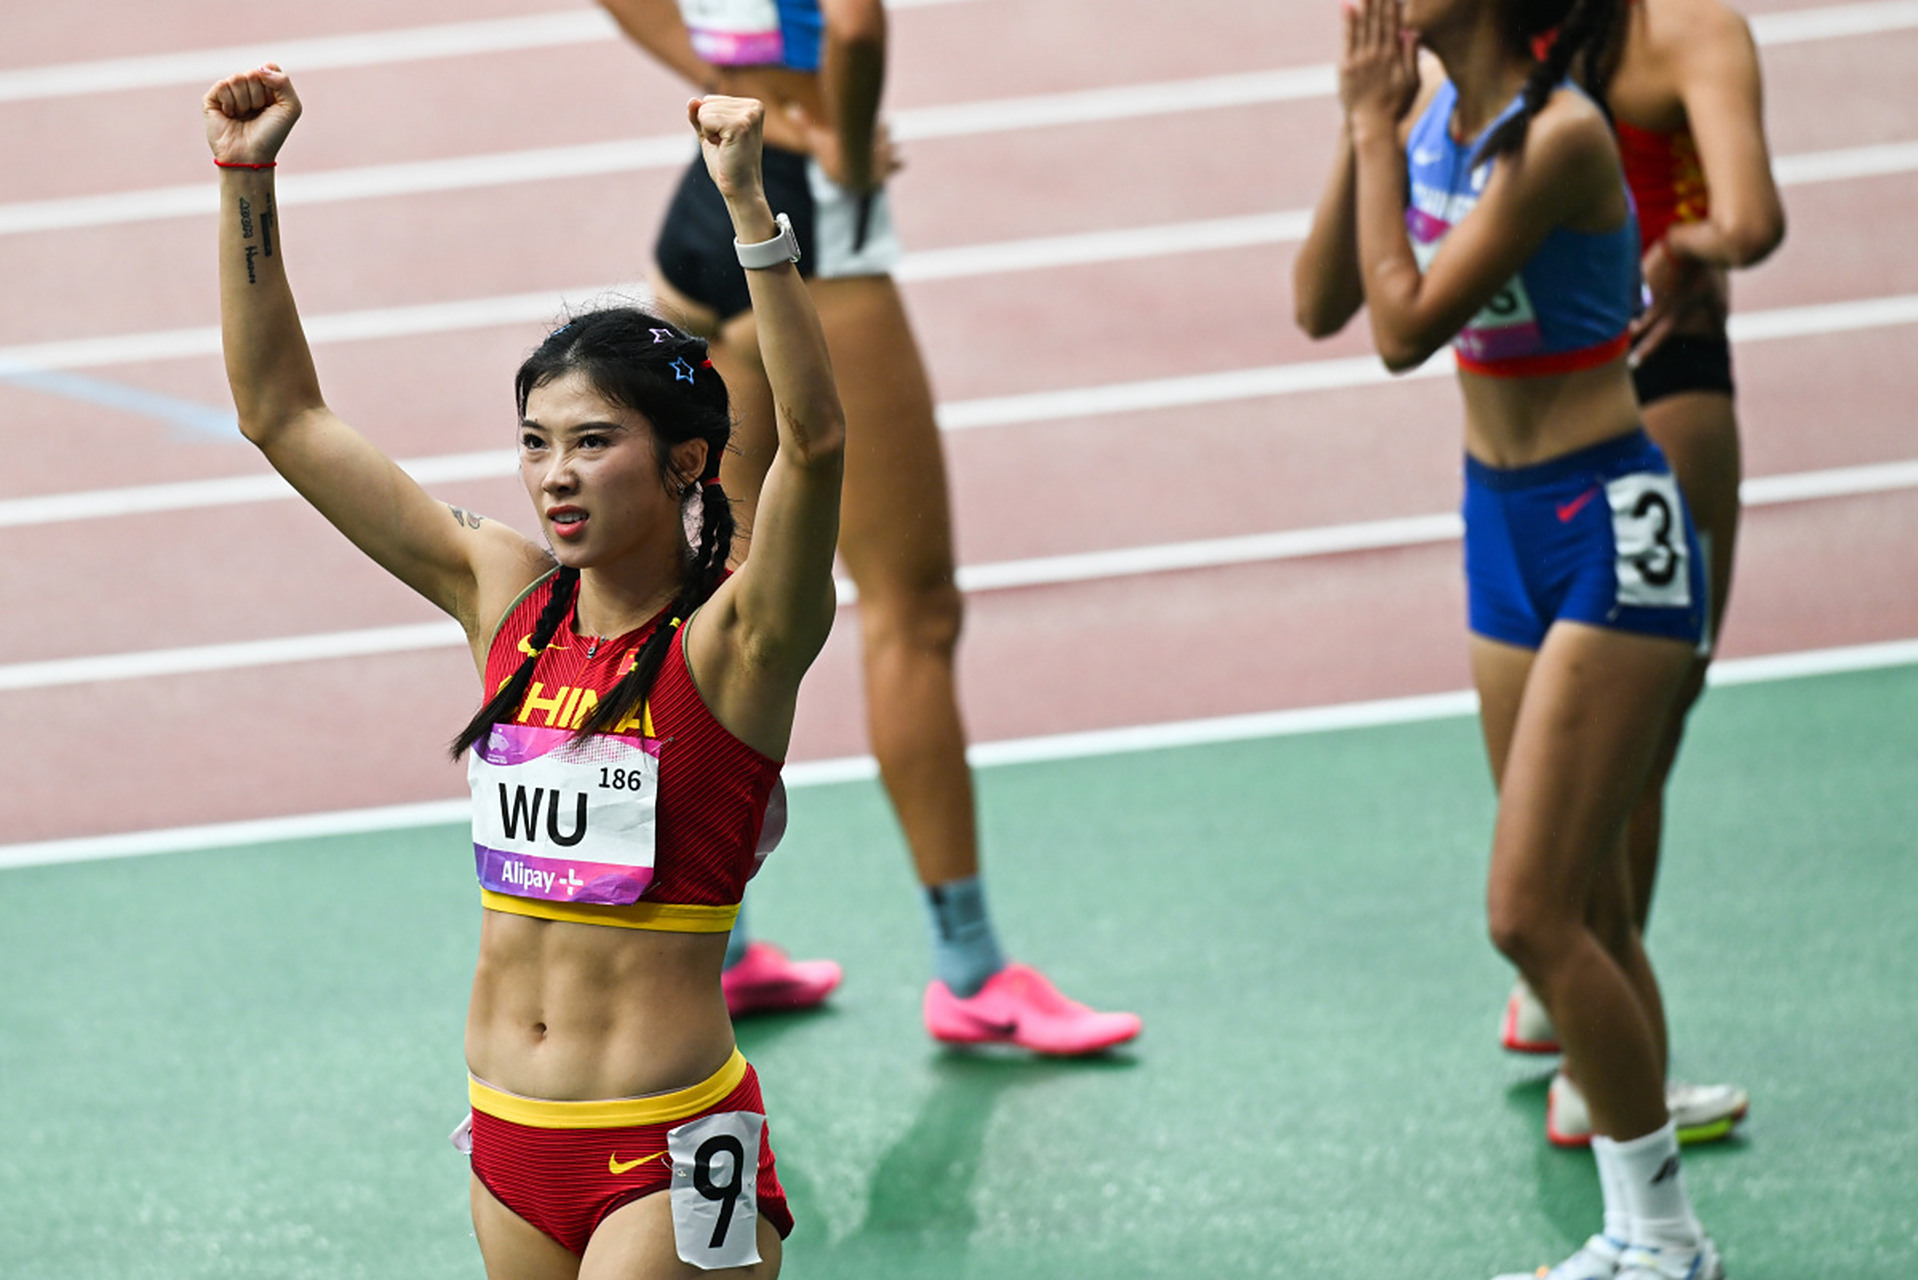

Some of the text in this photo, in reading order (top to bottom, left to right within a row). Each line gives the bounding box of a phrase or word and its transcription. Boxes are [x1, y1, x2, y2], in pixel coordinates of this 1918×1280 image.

[1632, 490, 1678, 588] 3
[498, 782, 588, 847] WU
[598, 767, 641, 791] 186
[693, 1134, 744, 1248] 9
